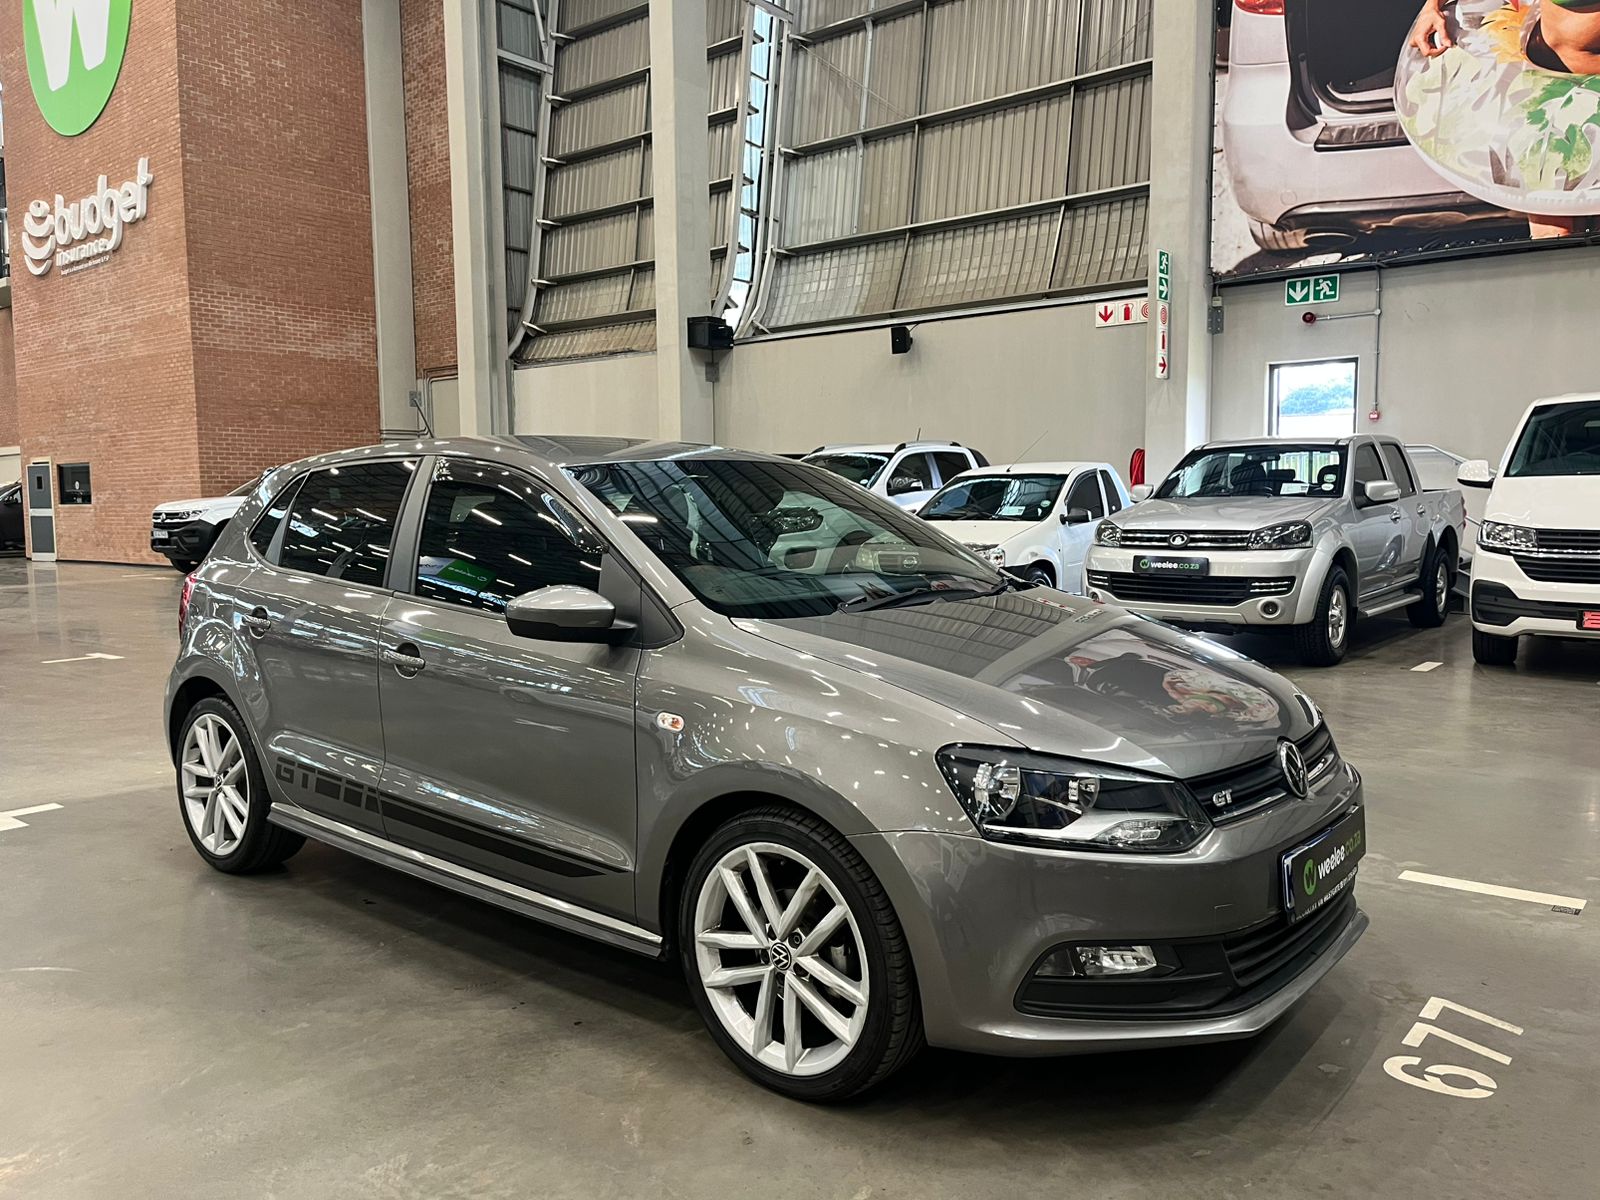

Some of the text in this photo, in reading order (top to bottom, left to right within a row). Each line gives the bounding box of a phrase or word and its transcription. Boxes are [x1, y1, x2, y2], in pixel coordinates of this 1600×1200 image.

[54, 157, 154, 252] budget
[1212, 789, 1233, 807] GT
[1382, 996, 1525, 1099] 677
